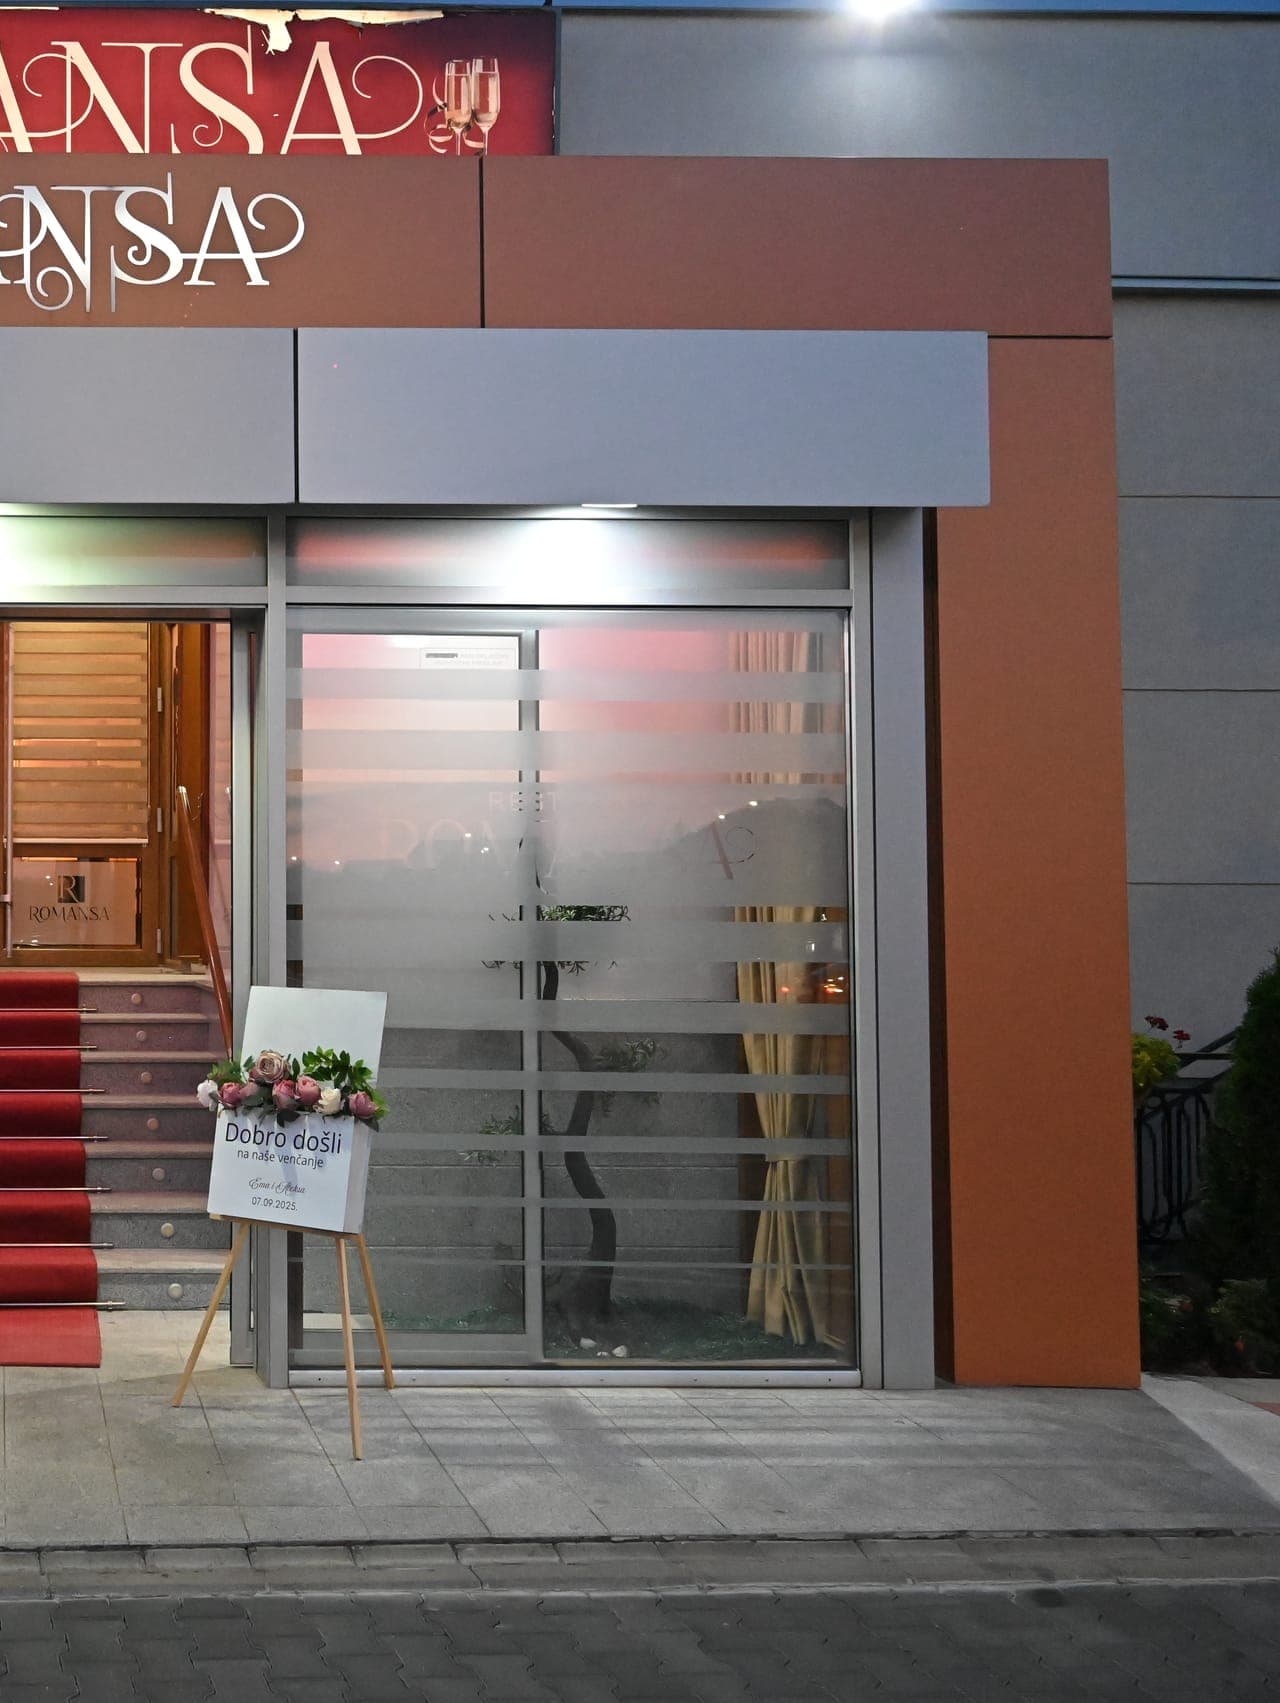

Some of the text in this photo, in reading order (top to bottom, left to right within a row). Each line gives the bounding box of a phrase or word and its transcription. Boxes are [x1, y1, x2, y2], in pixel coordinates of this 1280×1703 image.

[29, 905, 110, 923] ROMANSA
[225, 1122, 342, 1154] Dobro došli
[237, 1149, 324, 1170] na naše venčanje
